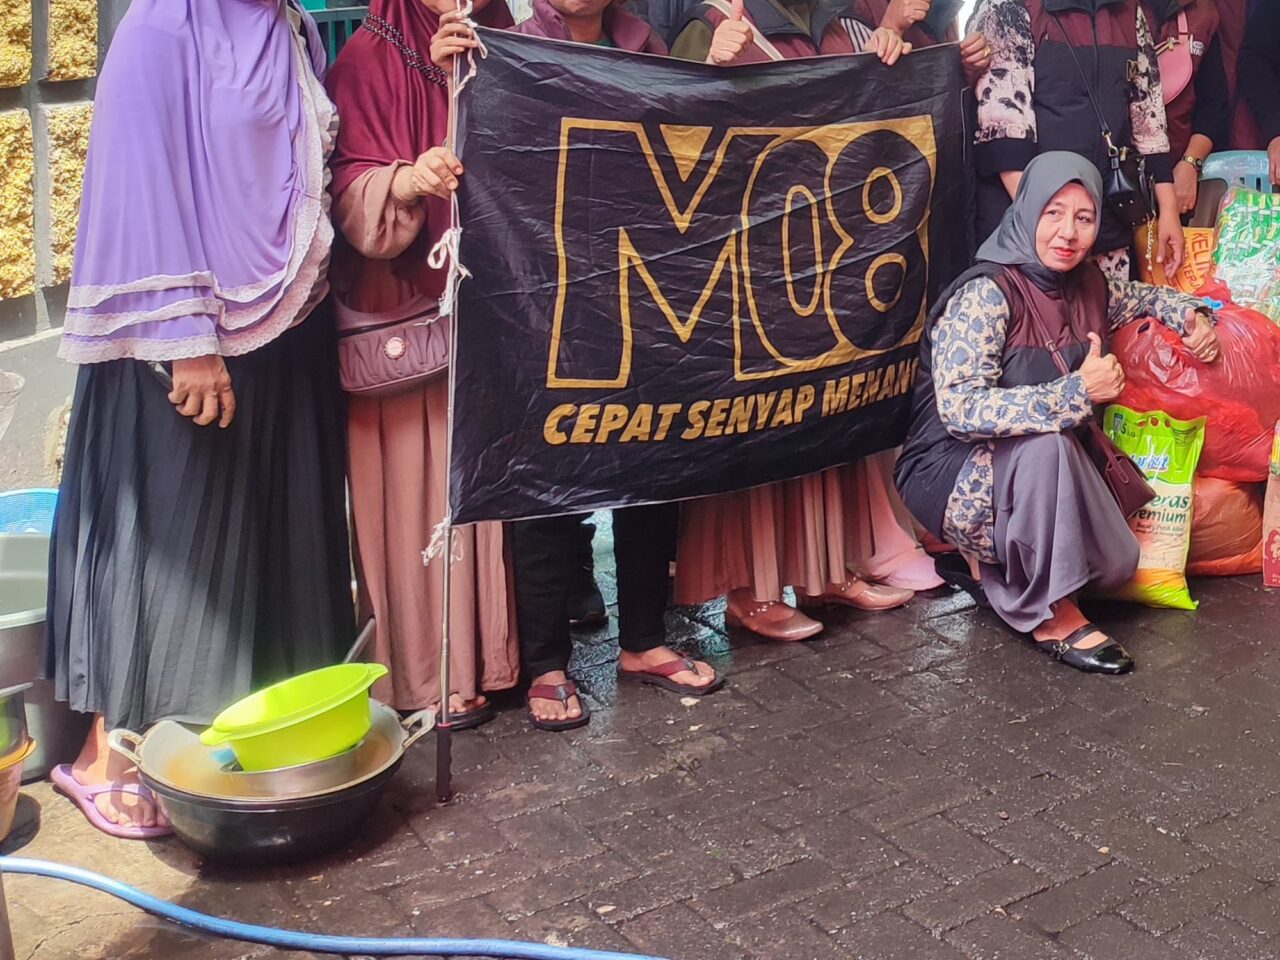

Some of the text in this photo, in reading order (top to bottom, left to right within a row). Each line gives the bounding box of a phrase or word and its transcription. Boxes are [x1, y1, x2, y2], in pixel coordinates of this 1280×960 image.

[543, 401, 681, 446] CEPAT
[682, 385, 818, 441] SENYAP
[1150, 494, 1190, 509] eras
[1132, 508, 1187, 523] remium
